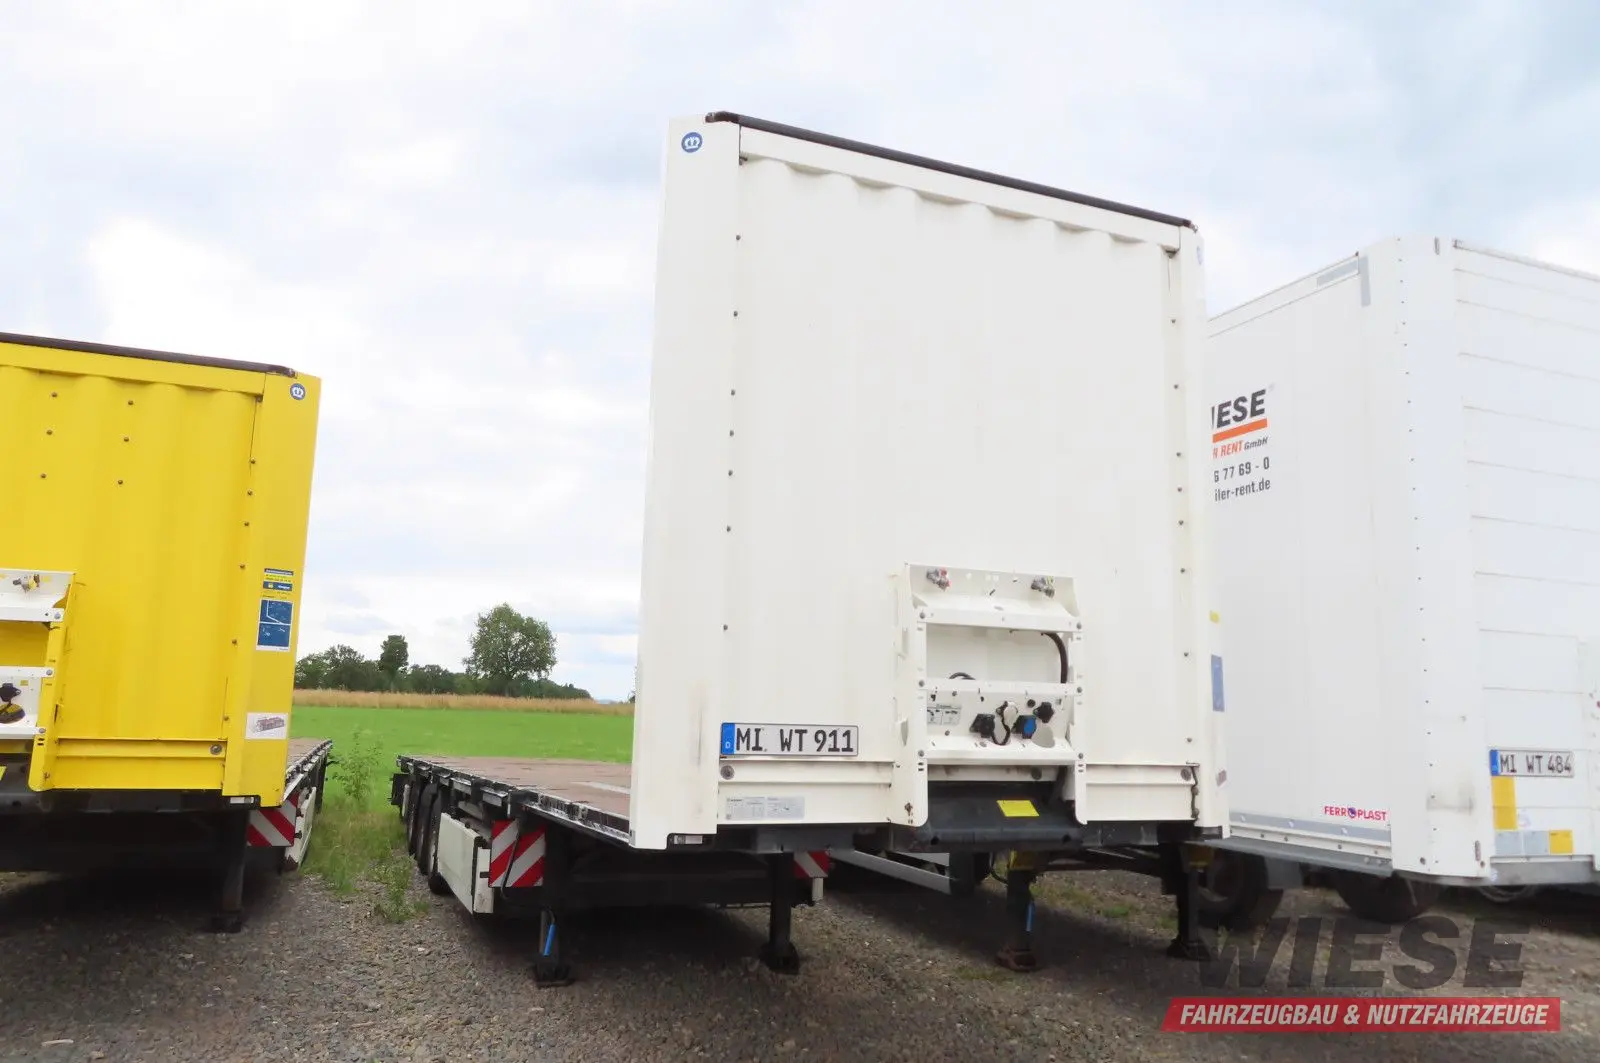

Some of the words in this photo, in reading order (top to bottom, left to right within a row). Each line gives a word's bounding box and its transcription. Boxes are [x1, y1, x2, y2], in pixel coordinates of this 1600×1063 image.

[1220, 441, 1244, 457] RENT
[1244, 437, 1269, 450] GmbH
[1223, 466, 1235, 480] 77
[1239, 462, 1252, 476] 69
[736, 727, 764, 752] MI
[779, 729, 808, 752] WT
[814, 729, 854, 752] 911
[1500, 754, 1517, 774] MI
[1526, 755, 1543, 774] WT
[1548, 755, 1572, 774] 484
